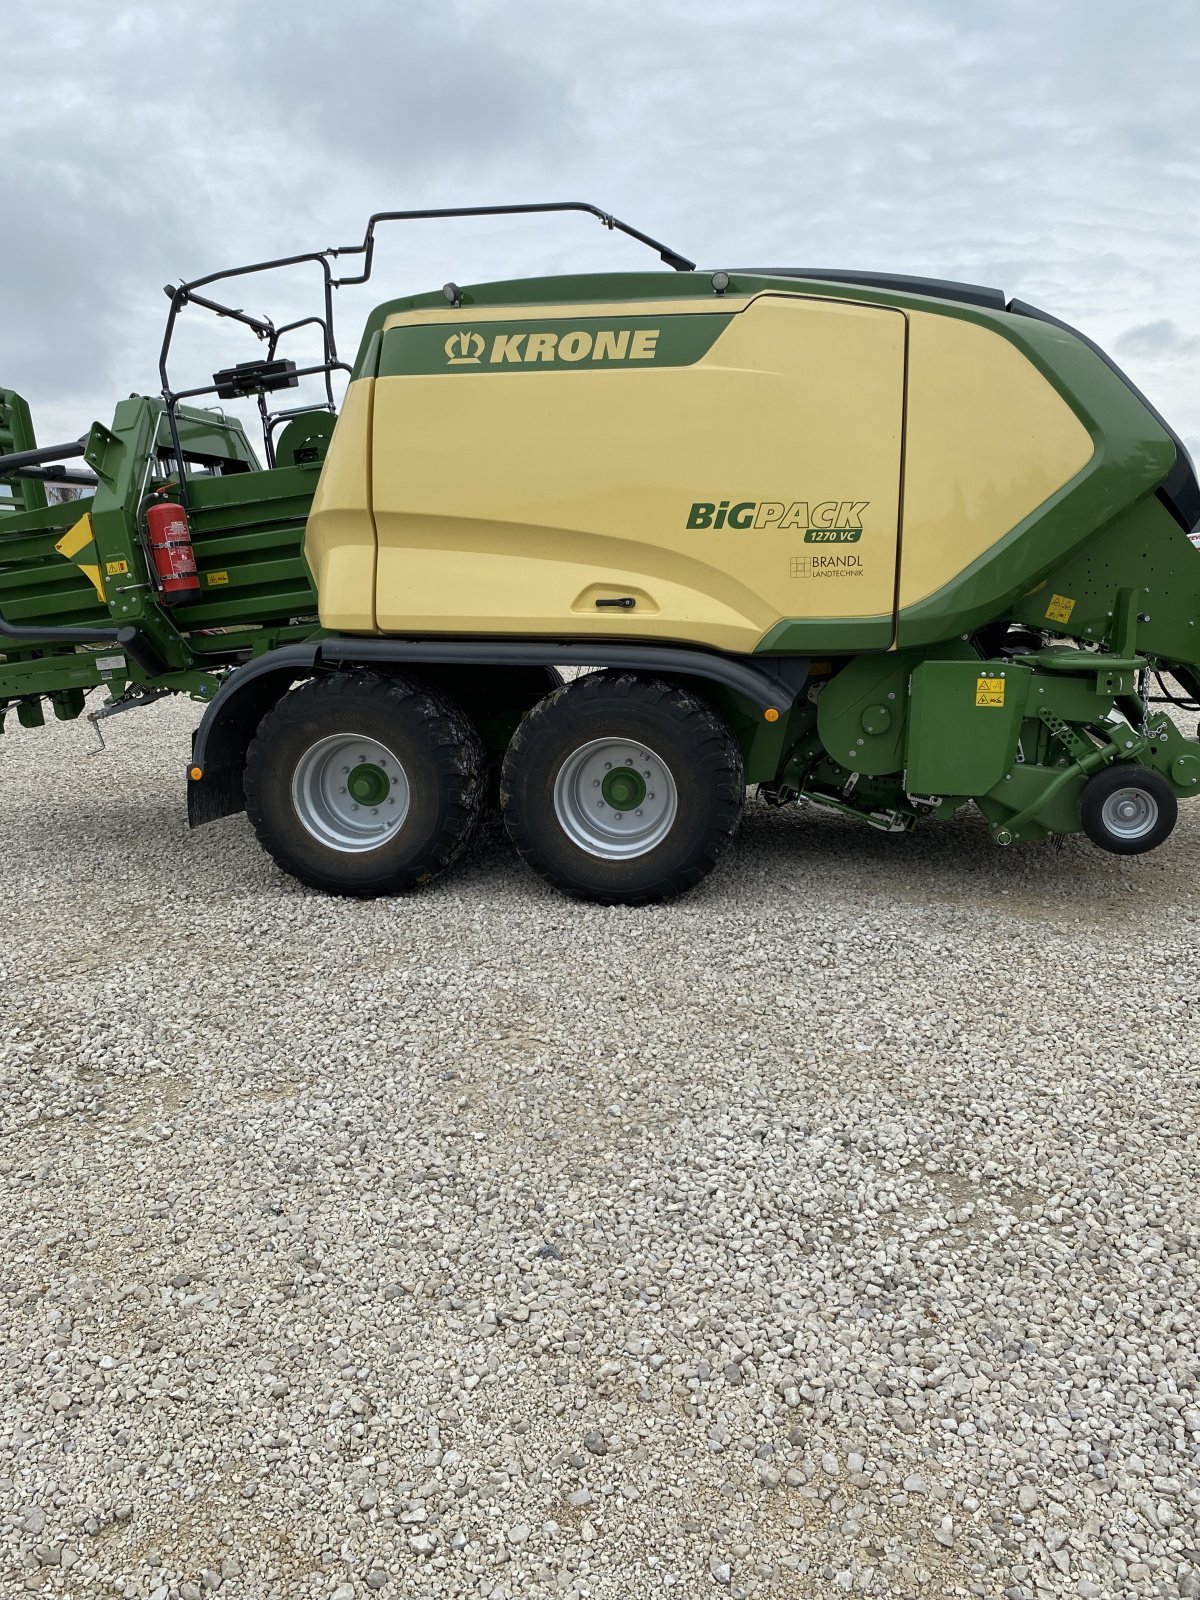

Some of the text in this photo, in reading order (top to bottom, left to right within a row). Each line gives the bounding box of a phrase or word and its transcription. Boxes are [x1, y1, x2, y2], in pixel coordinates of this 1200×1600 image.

[489, 329, 660, 364] KRONE
[810, 532, 856, 541] 1270 VC
[812, 555, 863, 568] BRANDL
[812, 569, 864, 578] LANDTECHNIK
